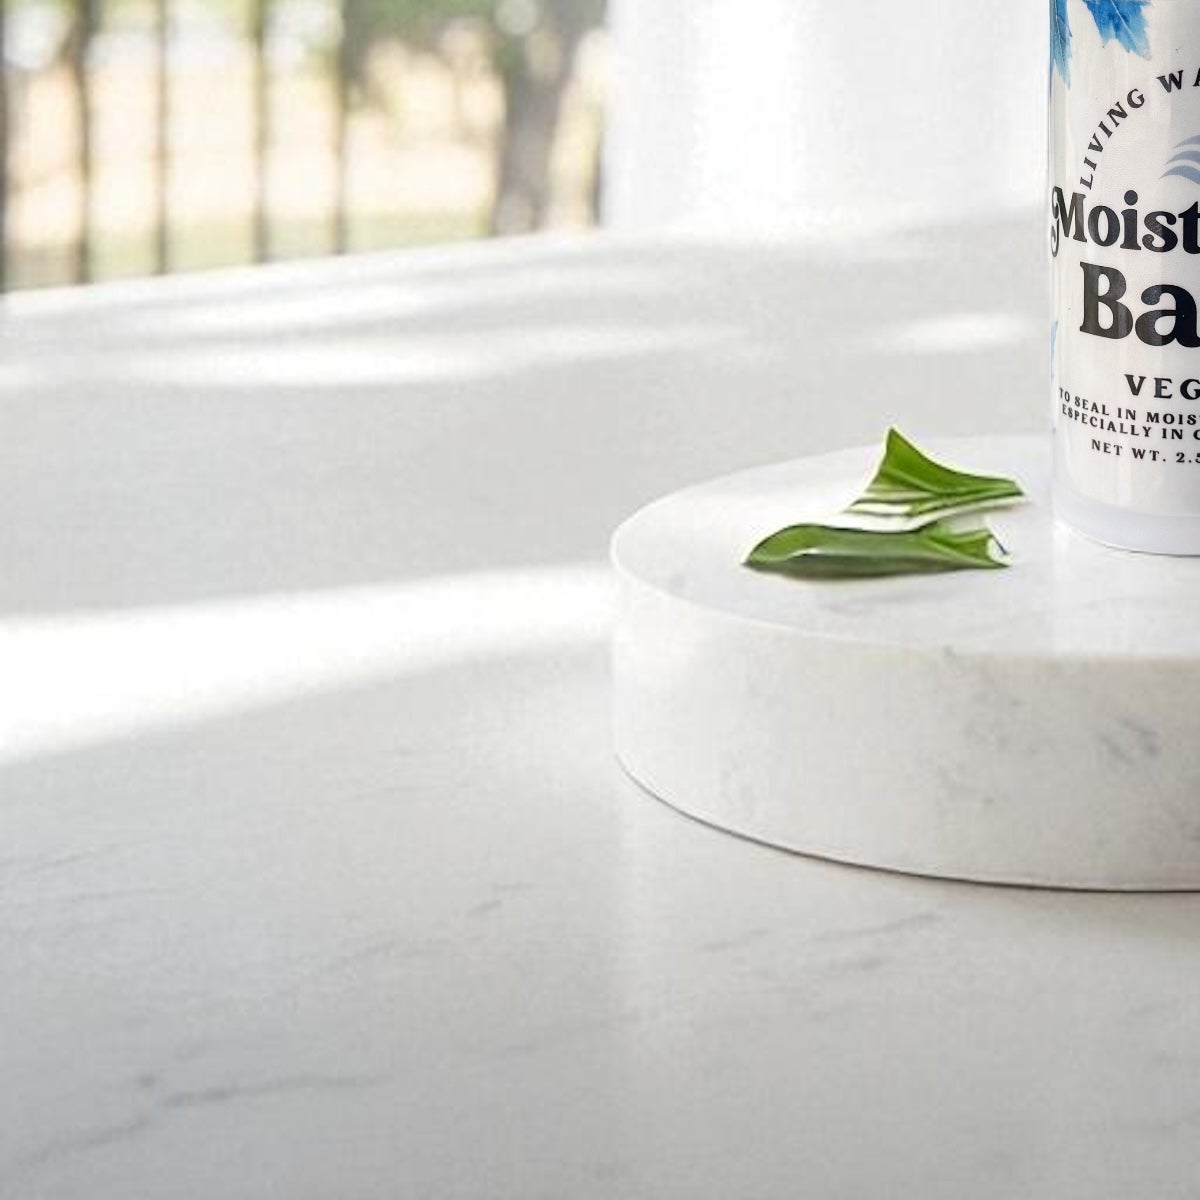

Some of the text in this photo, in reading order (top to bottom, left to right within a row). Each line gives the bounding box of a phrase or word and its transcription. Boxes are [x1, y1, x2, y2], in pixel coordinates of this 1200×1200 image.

[1080, 88, 1145, 190] LIVING
[1059, 387, 1071, 402] TO
[1075, 396, 1109, 416] SEAL
[1117, 407, 1136, 420] IN
[1062, 403, 1151, 437] ESPECIALLY
[1162, 428, 1183, 440] IN
[1091, 439, 1122, 456] NET
[1132, 447, 1166, 461] WT.
